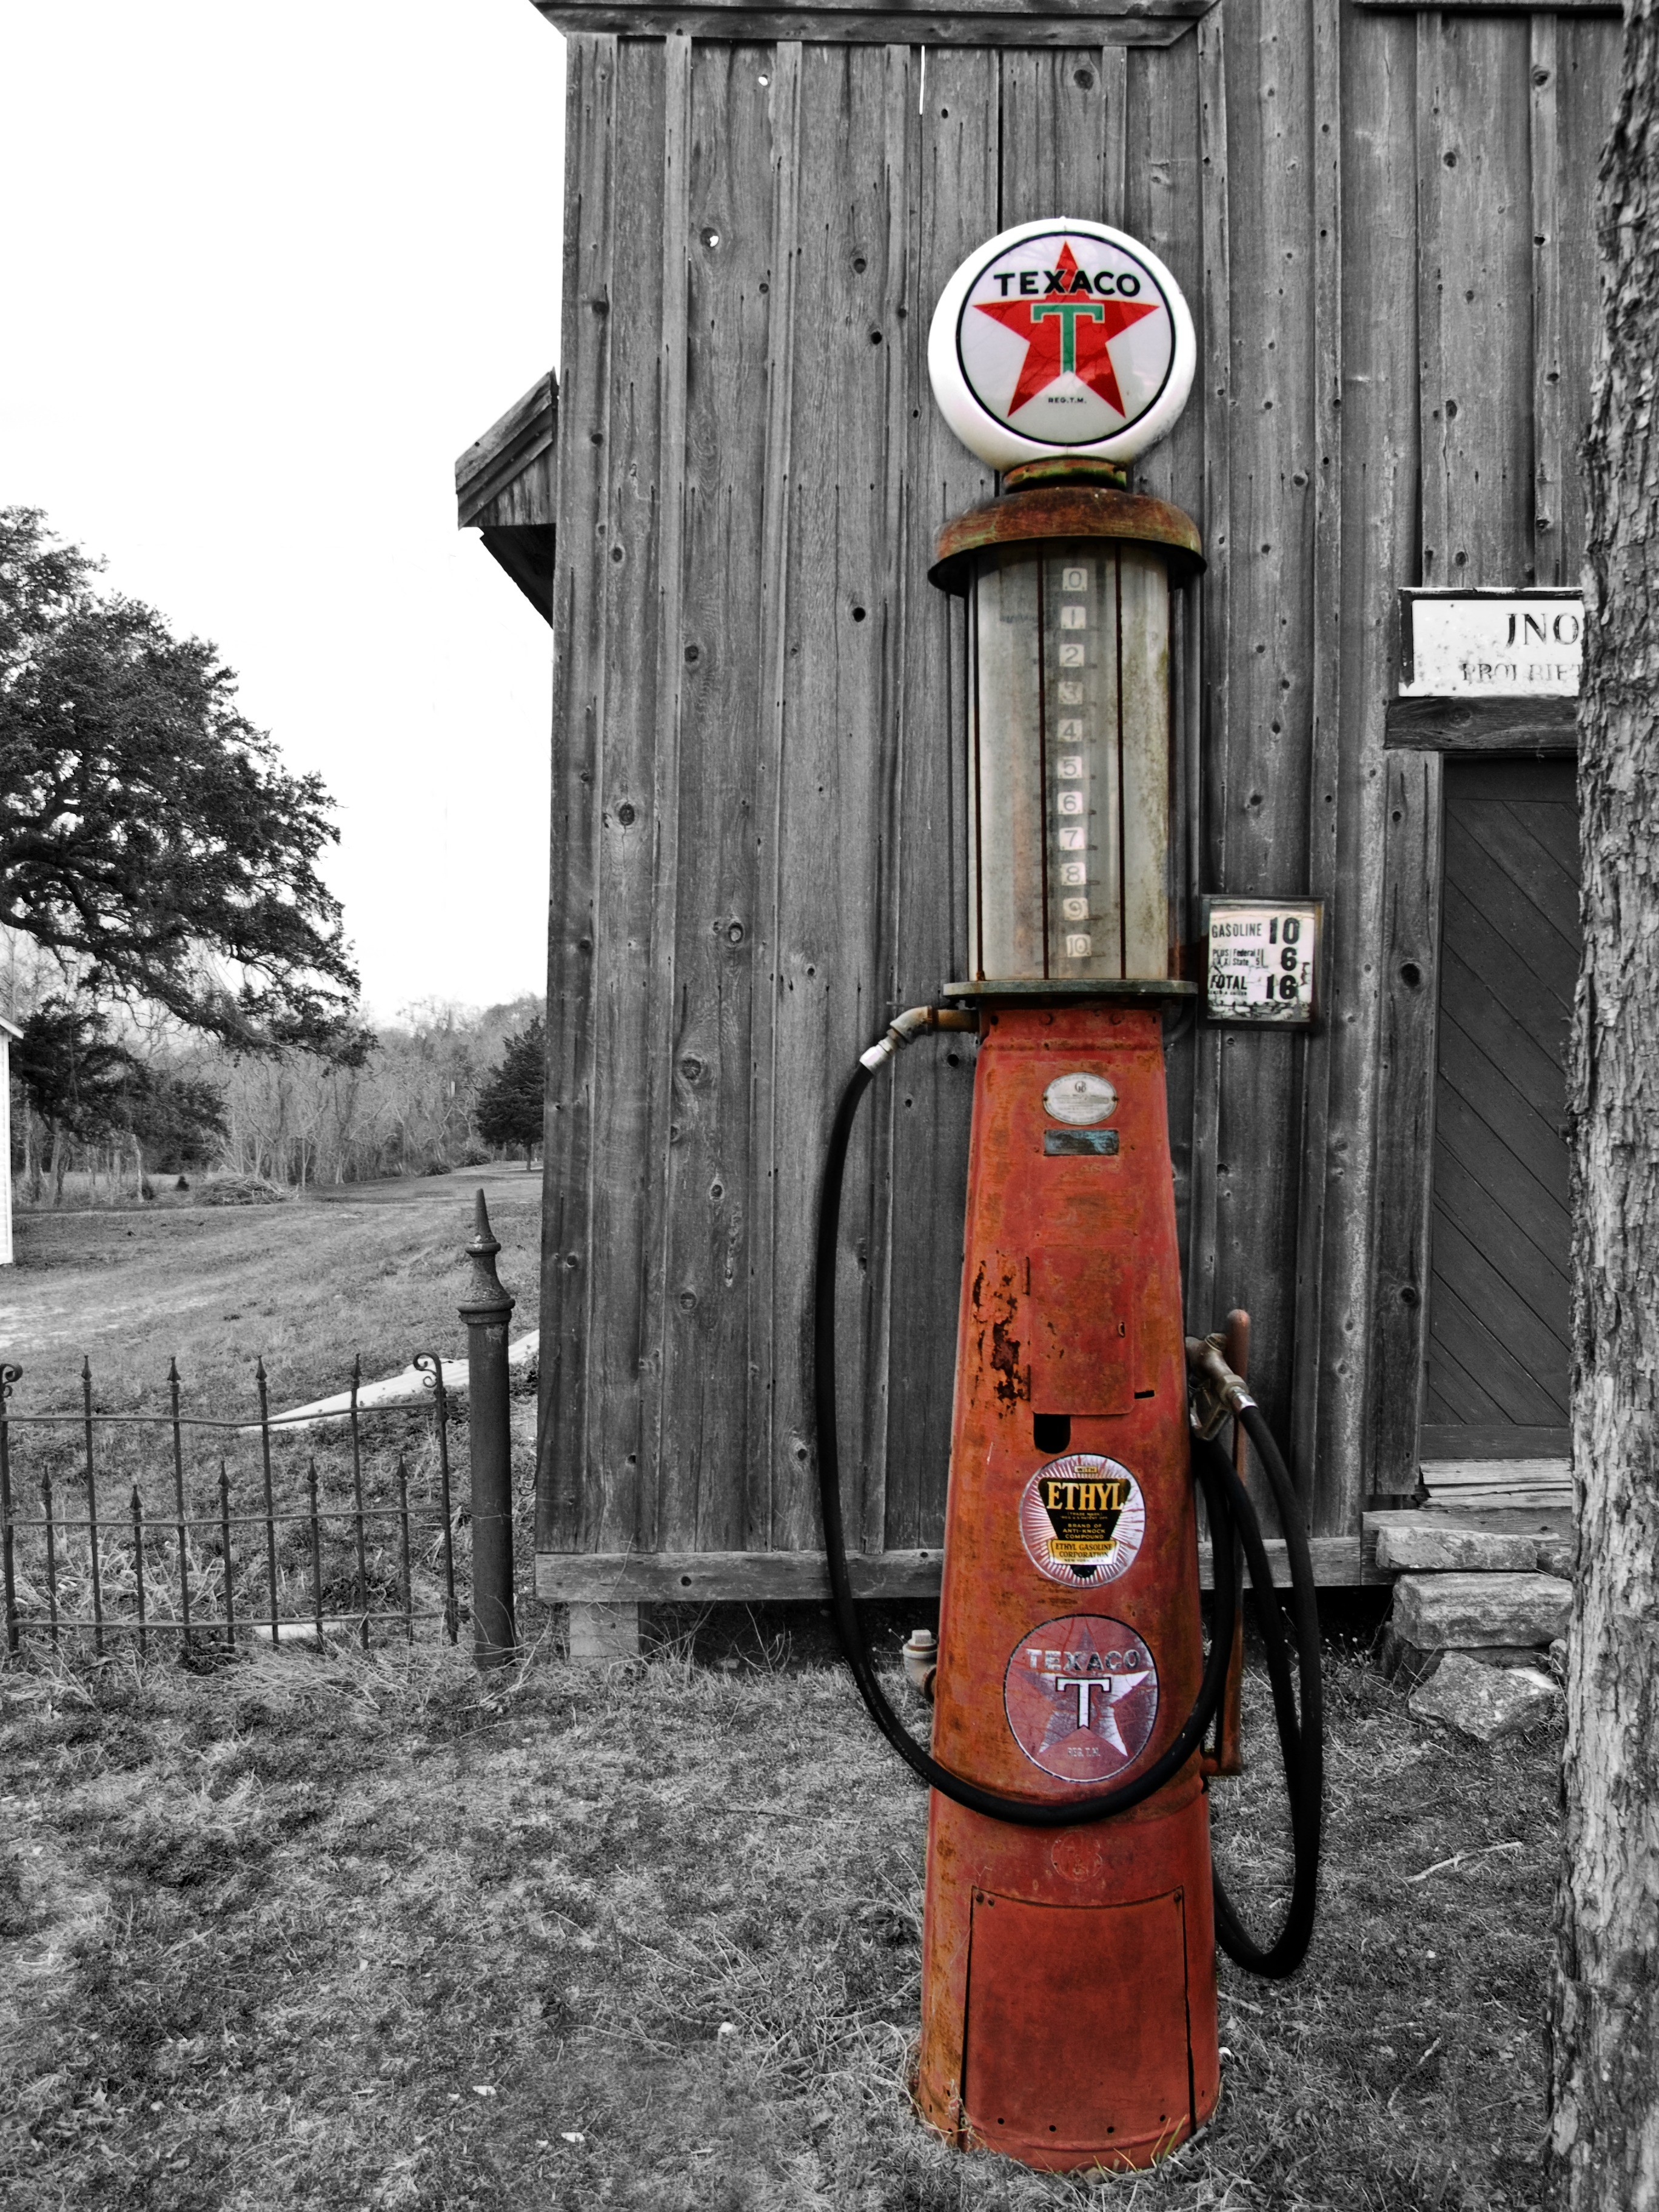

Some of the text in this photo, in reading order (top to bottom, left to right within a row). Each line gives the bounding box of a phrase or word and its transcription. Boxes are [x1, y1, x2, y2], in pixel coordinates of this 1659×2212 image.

[994, 269, 1141, 297] TEXACO
[1031, 303, 1105, 375] T
[1068, 571, 1082, 588] 0
[1065, 646, 1079, 663] 2
[1064, 683, 1077, 701] 3
[1063, 722, 1076, 737] 4
[1064, 762, 1077, 776] 5
[1063, 795, 1076, 811] 6
[1065, 830, 1078, 847] 7
[1066, 865, 1081, 883] 8
[1068, 900, 1083, 917] 9
[1212, 917, 1300, 945] GASOLINE 10
[1070, 937, 1088, 955] 10
[1281, 947, 1298, 971] 6
[1210, 974, 1296, 1000] TOTAL 16
[1047, 1481, 1124, 1510] ETHYL
[1026, 1648, 1140, 1671] TEXACO
[1055, 1677, 1111, 1729] T
